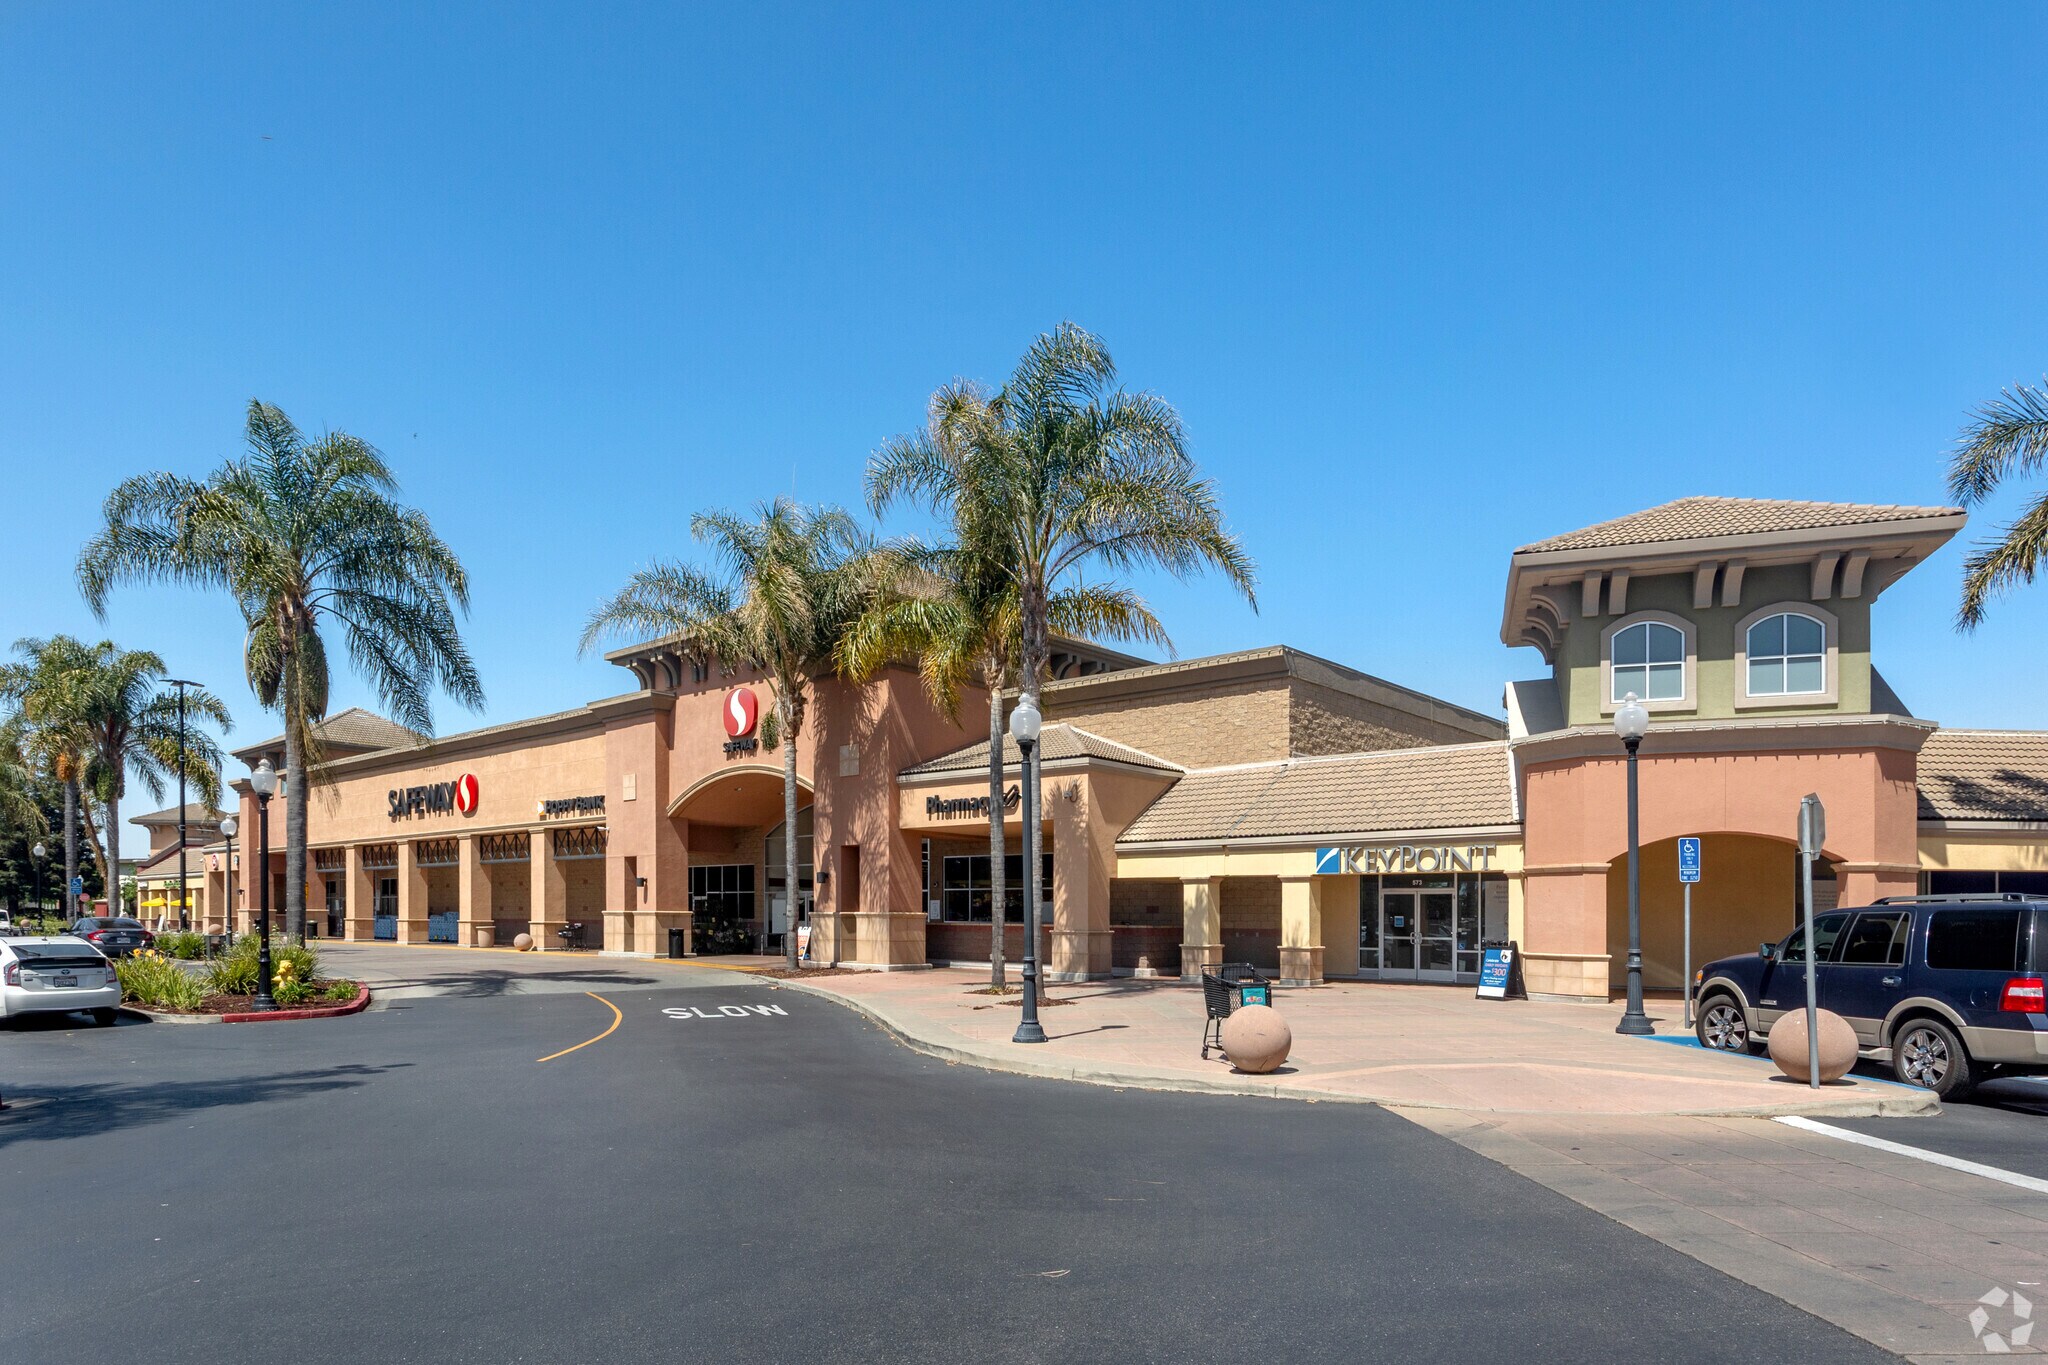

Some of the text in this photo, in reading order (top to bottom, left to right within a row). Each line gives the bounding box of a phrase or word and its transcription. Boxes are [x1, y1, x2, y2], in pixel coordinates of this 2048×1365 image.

[723, 739, 759, 752] SAFEWAY
[388, 781, 457, 817] SAFEWAY
[544, 795, 605, 815] POPPY BANK
[1342, 844, 1496, 873] KEYPOINT
[662, 1004, 789, 1019] SLOW
